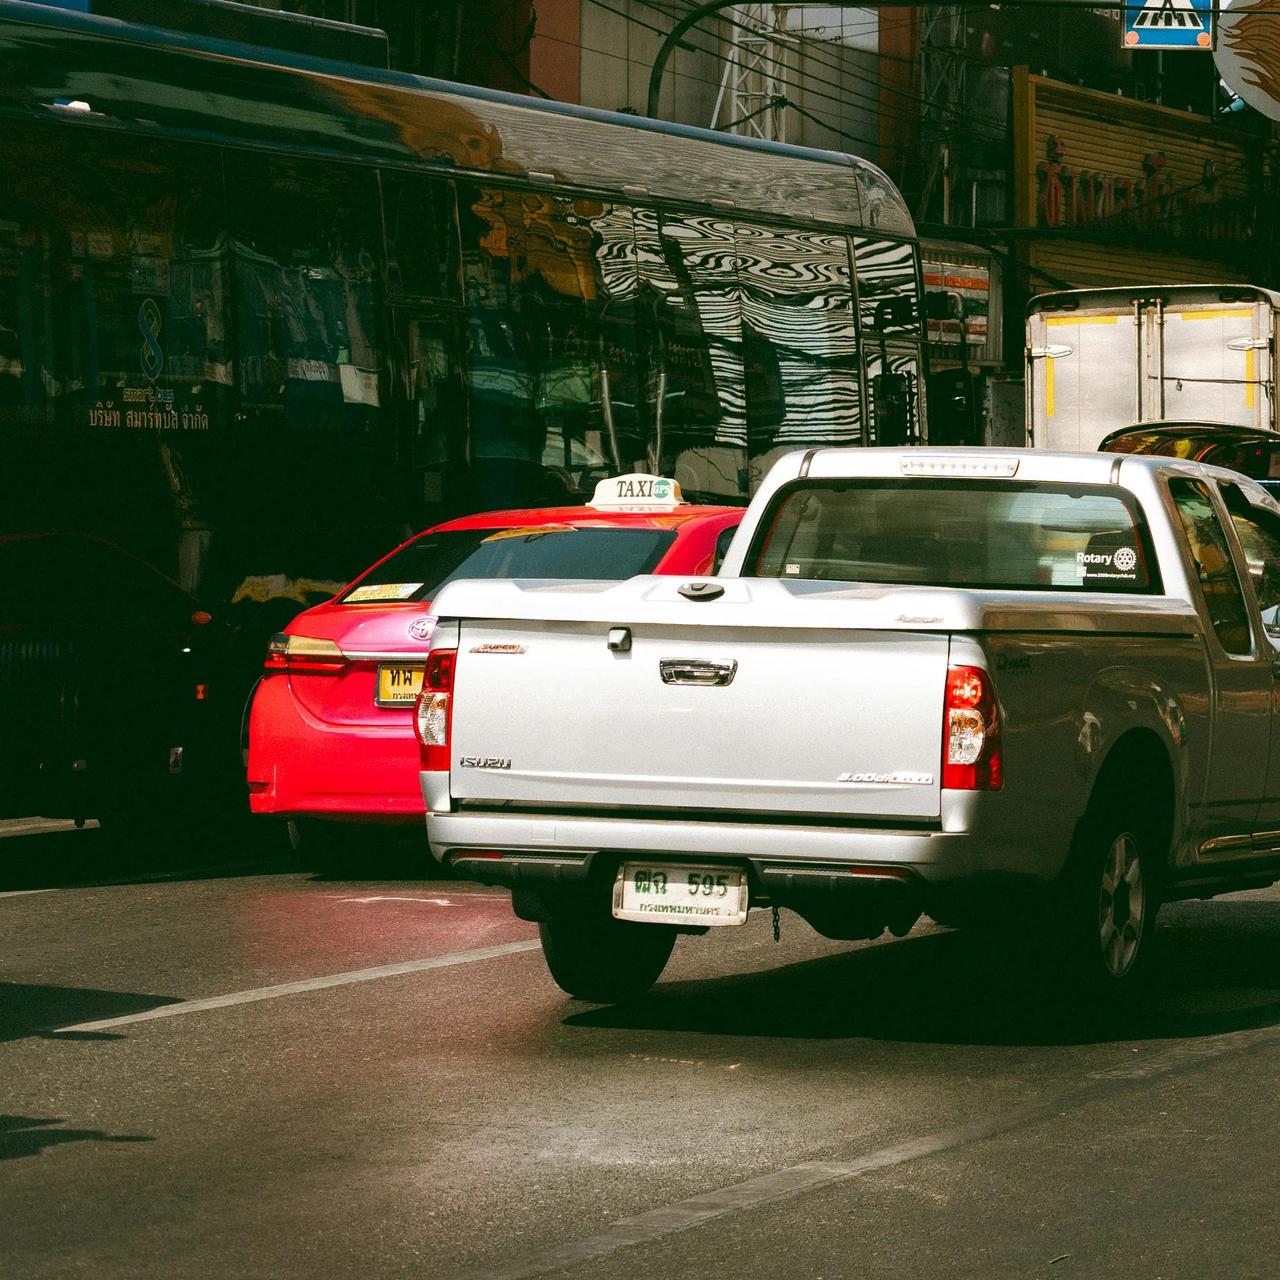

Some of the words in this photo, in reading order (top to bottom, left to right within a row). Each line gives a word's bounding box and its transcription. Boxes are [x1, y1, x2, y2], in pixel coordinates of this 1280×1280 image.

[89, 401, 121, 428] บริษัท
[617, 480, 655, 498] TAXI
[653, 484, 672, 495] GPS
[1076, 552, 1113, 566] Rotary
[460, 756, 512, 770] ISUZU
[687, 872, 730, 899] 595
